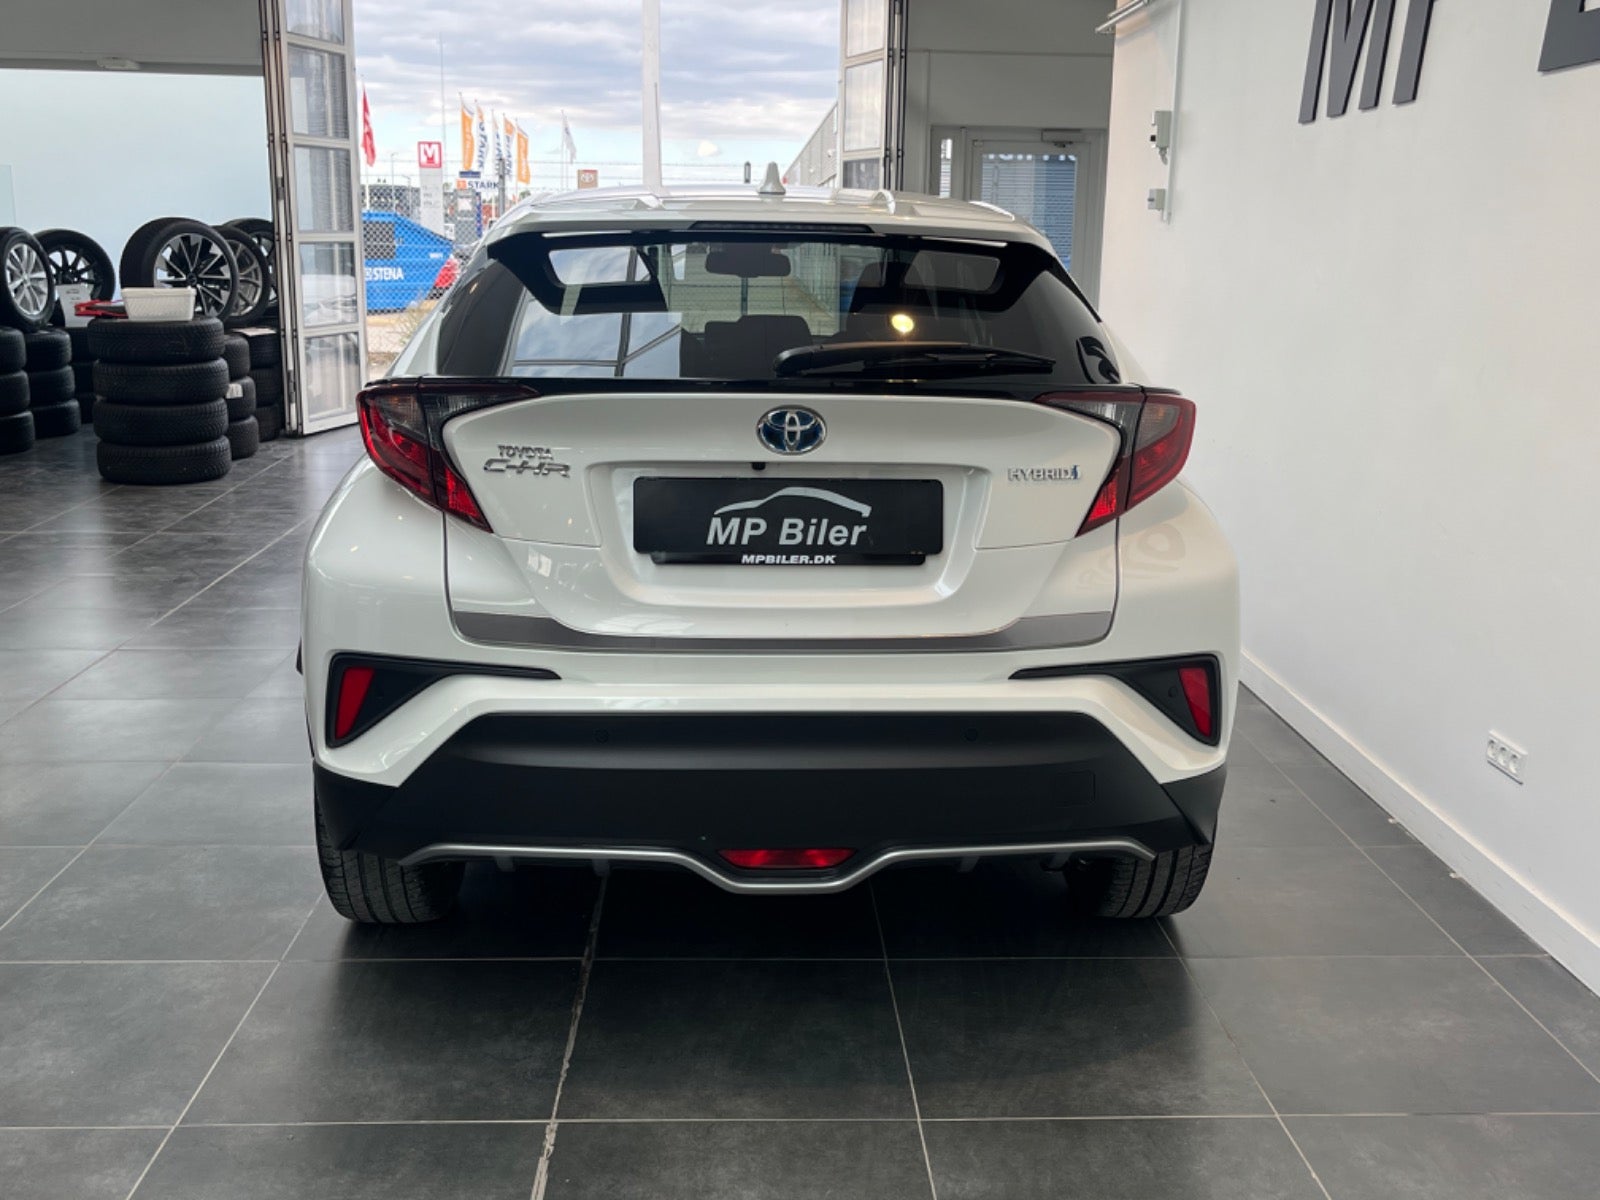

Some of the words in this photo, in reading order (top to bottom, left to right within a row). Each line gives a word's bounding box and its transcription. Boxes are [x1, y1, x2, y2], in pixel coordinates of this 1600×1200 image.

[467, 180, 499, 190] STARK
[498, 445, 554, 461] TOYOTA
[1007, 467, 1071, 482] HYBRID
[705, 516, 768, 546] MP
[778, 516, 868, 546] Biler
[740, 553, 836, 565] MPBILER.DK
